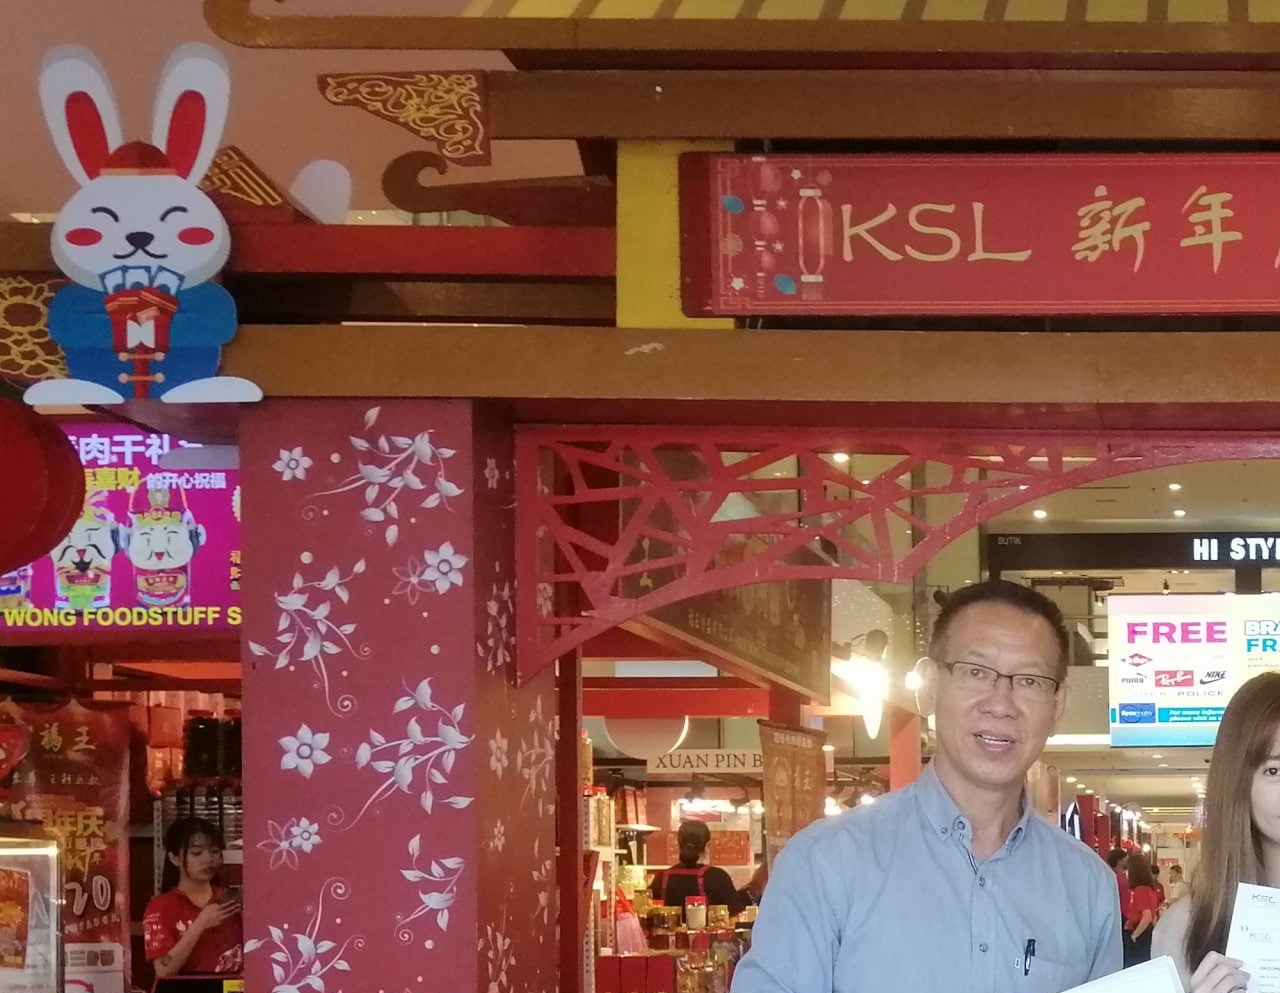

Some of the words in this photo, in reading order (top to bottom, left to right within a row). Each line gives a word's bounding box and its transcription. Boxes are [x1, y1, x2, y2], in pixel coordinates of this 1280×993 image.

[841, 202, 1032, 264] KSL
[1193, 538, 1218, 562] HI
[5, 608, 77, 627] WONG
[83, 606, 221, 626] FOODSTUFF
[1126, 621, 1228, 644] FREE
[656, 753, 709, 769] XUAN
[715, 753, 747, 769] PIN
